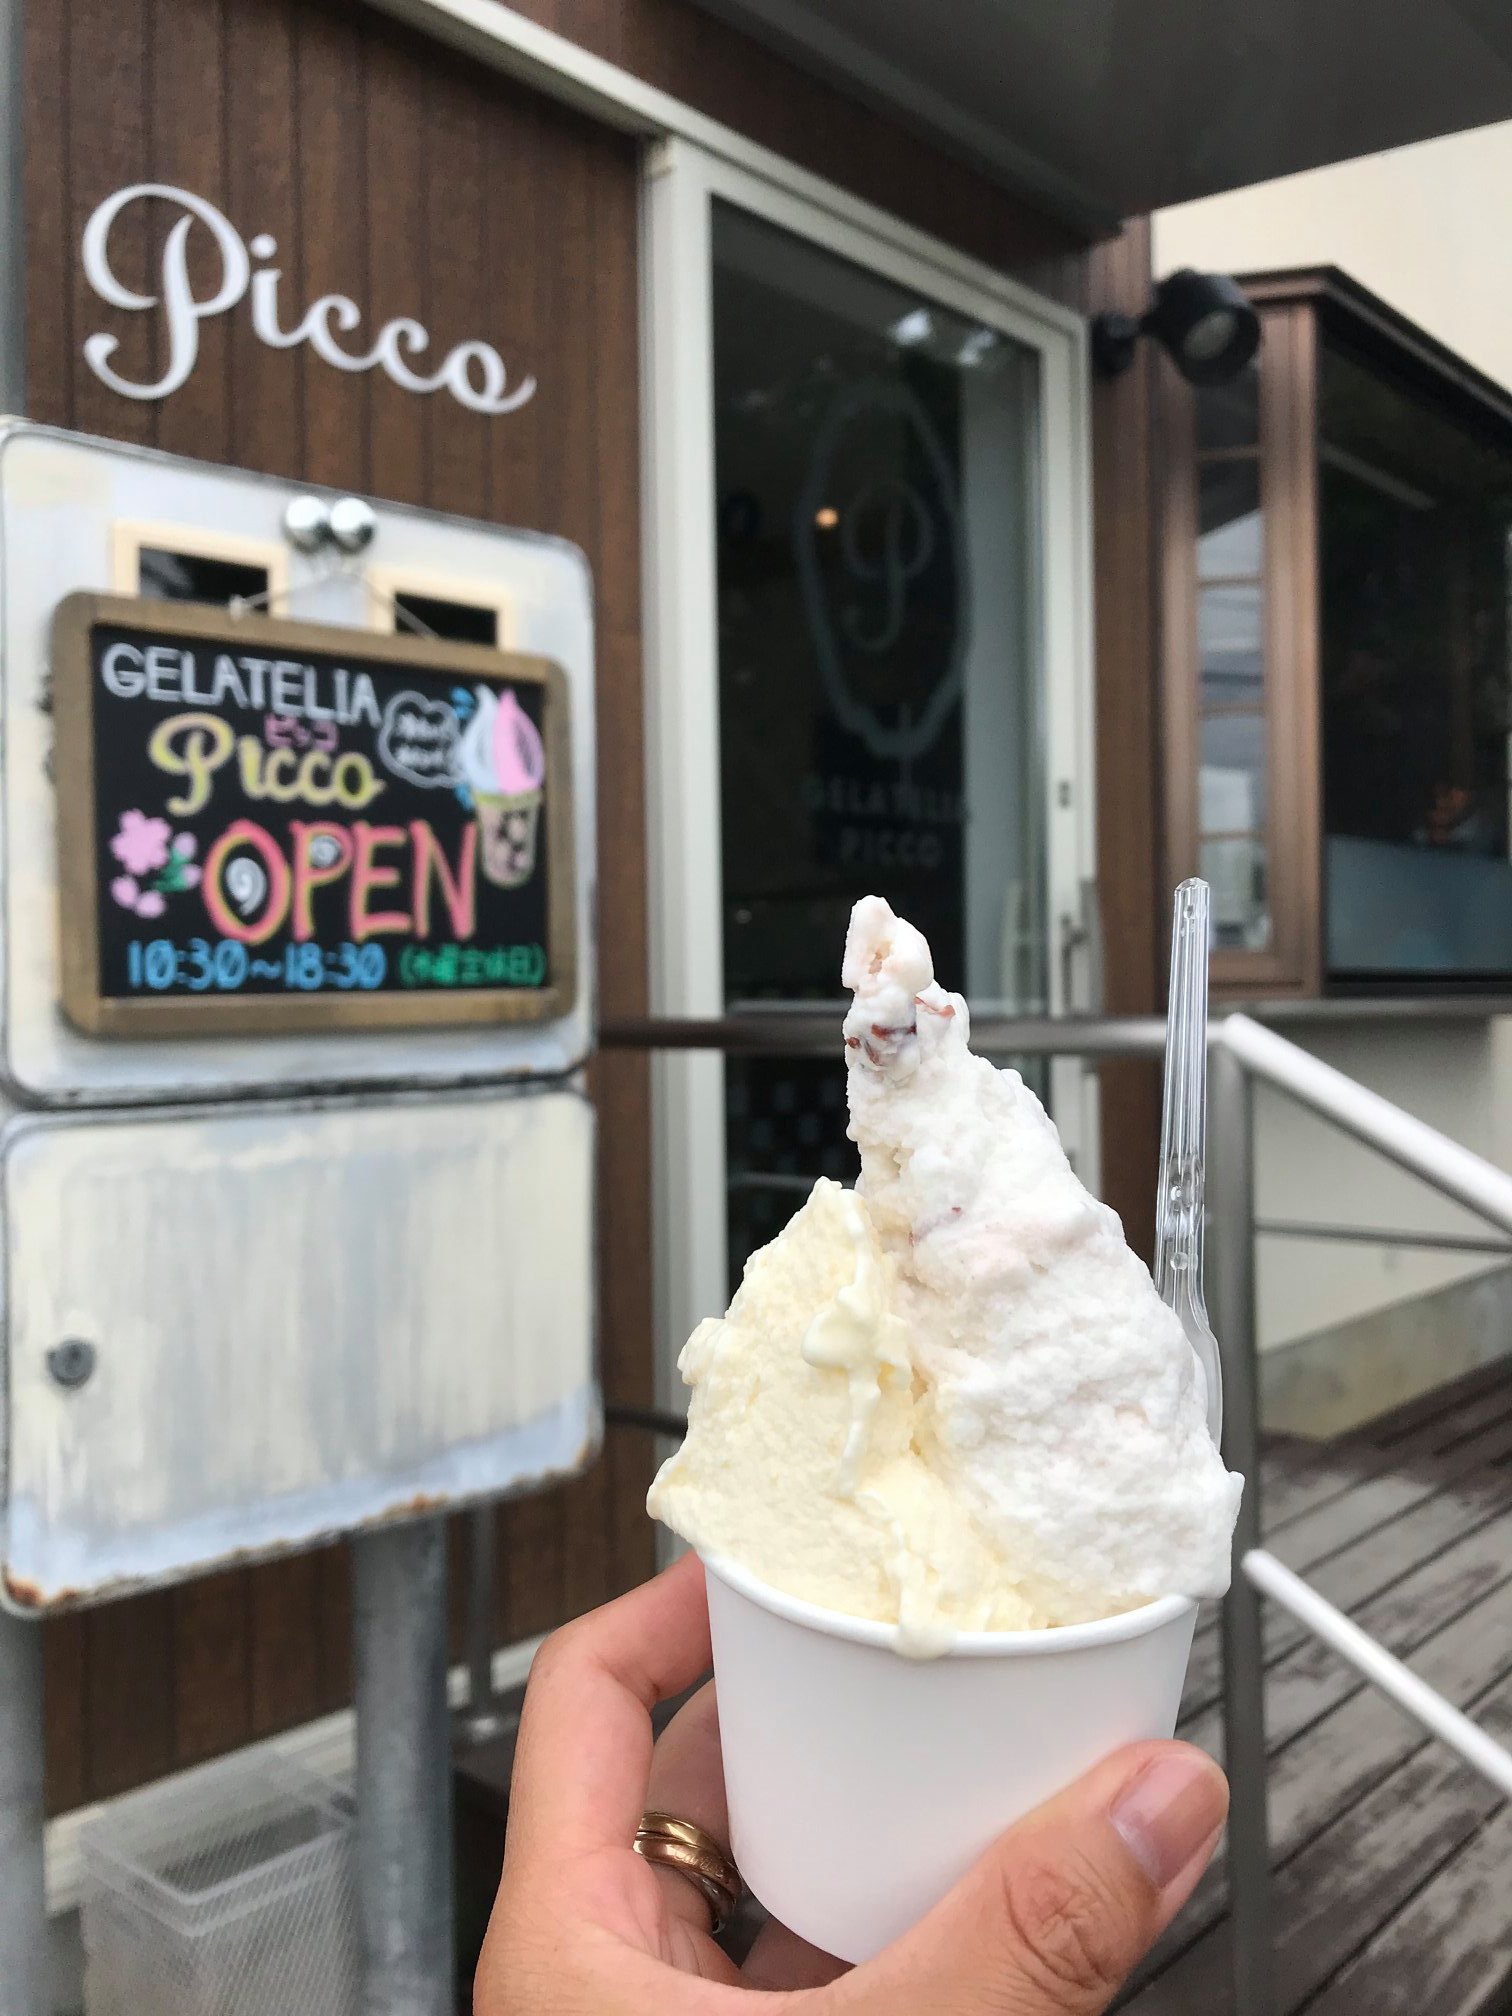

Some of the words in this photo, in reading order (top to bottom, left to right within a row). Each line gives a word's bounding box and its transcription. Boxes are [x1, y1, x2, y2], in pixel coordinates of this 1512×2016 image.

[82, 182, 537, 414] Picco
[101, 641, 382, 726] GELATELIA
[149, 712, 386, 816] Picco
[203, 819, 477, 944] OPEN
